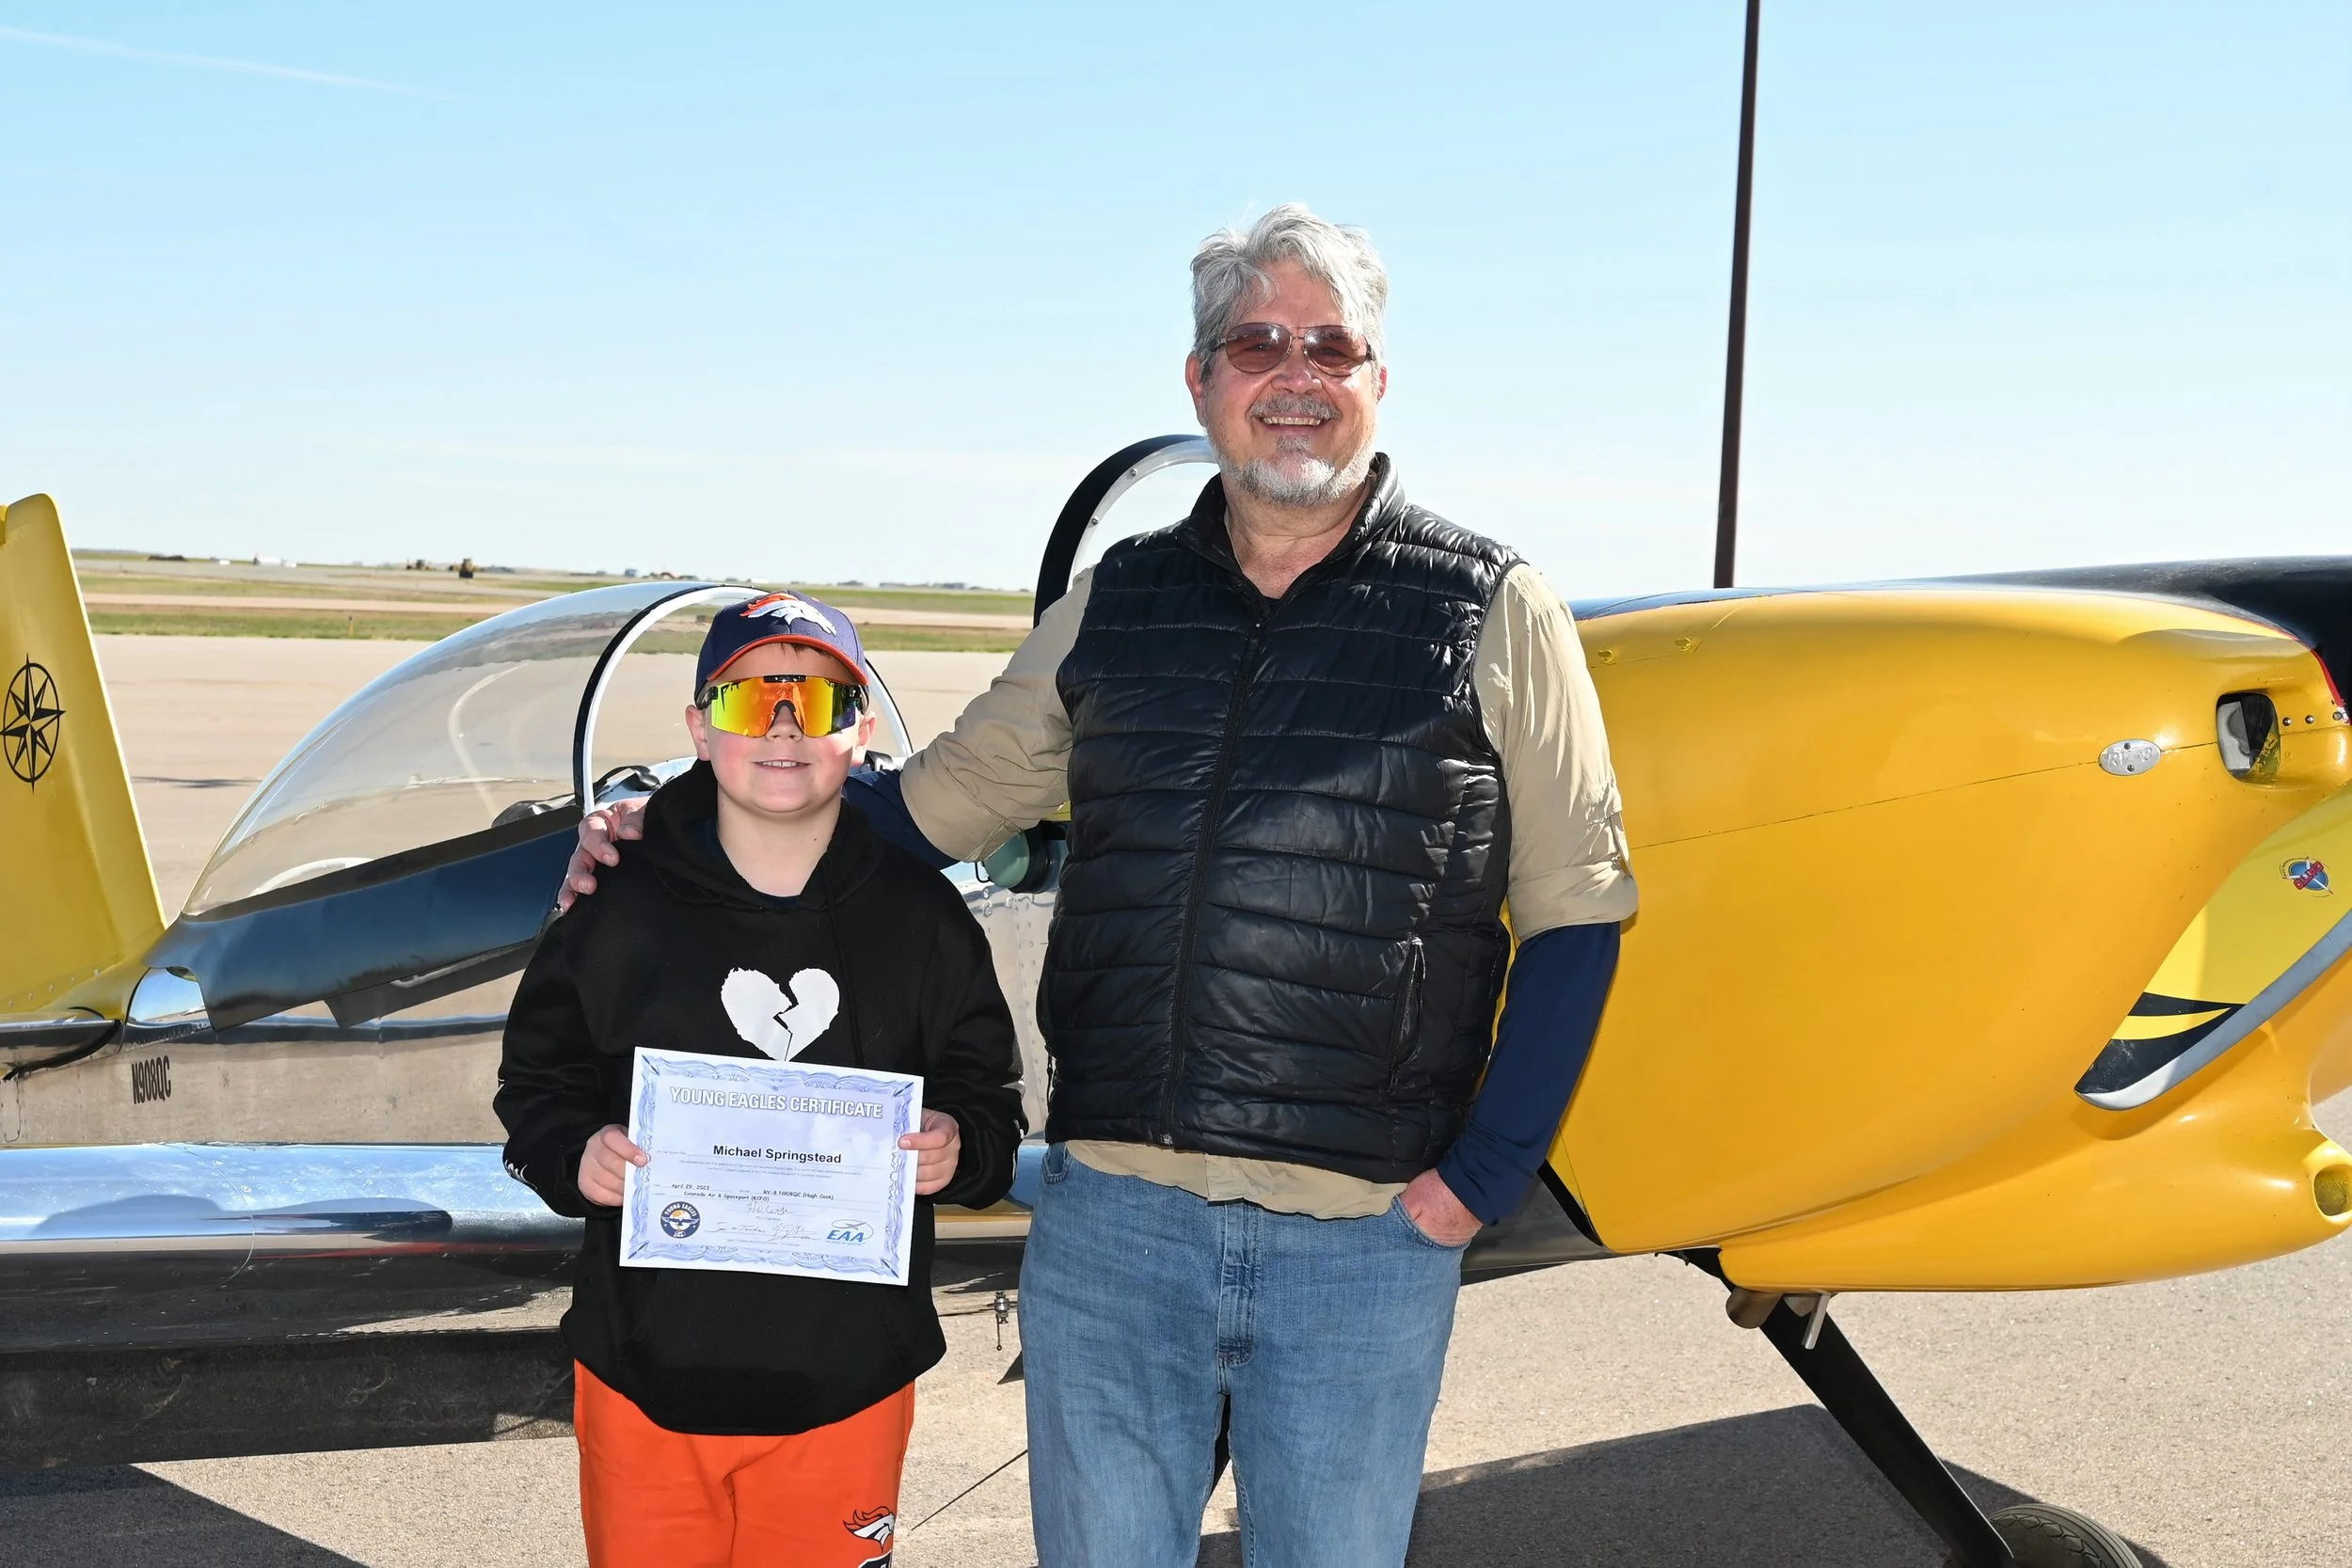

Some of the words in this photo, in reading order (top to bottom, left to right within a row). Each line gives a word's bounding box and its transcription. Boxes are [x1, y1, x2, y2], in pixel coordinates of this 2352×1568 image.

[132, 1055, 171, 1104] N908QC
[670, 1086, 725, 1106] YOUNG
[728, 1091, 787, 1111] EAGLES
[789, 1096, 882, 1118] CERTIFICATE
[713, 1145, 761, 1158] Michael
[765, 1148, 842, 1164] Springstead
[827, 1229, 865, 1243] EAA
